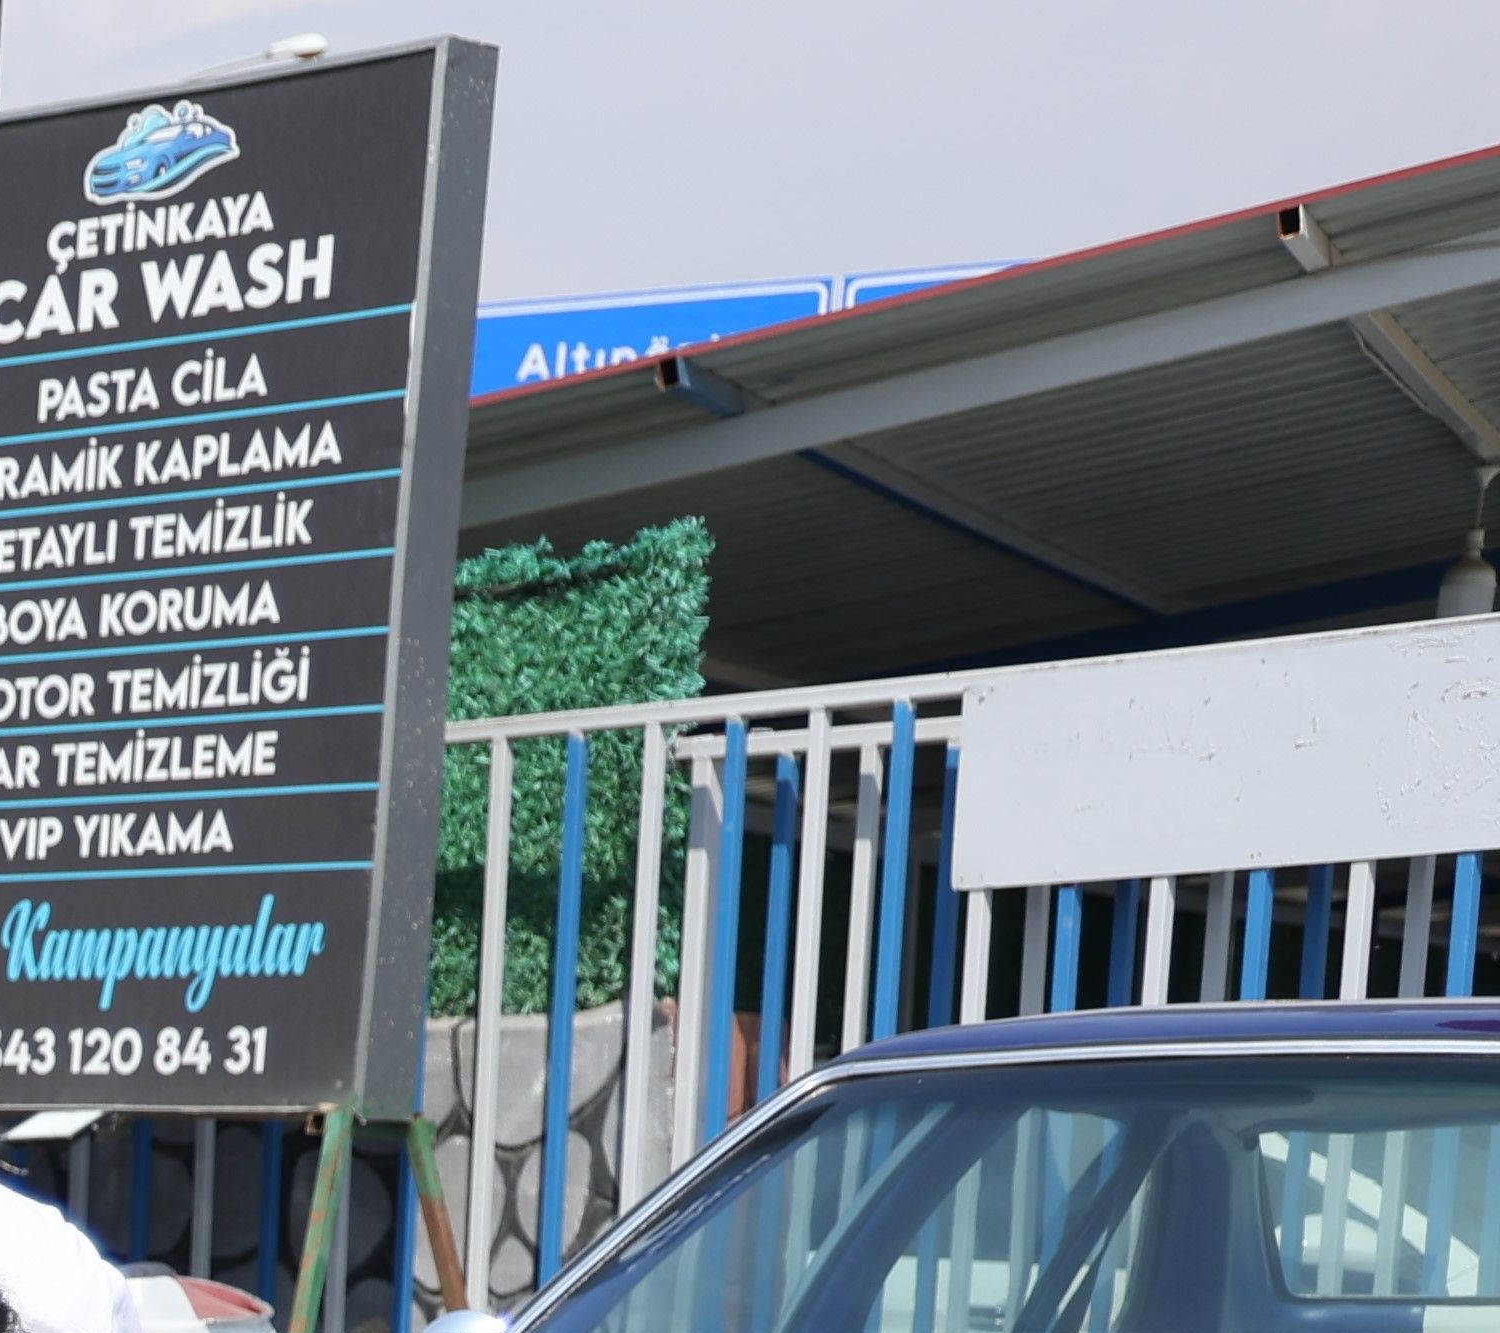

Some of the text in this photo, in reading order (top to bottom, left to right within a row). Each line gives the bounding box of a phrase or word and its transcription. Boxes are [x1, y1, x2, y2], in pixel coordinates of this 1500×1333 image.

[47, 189, 275, 273] ÇETİNKAYA
[140, 235, 336, 323] WASH
[38, 349, 268, 424] PASTA CİLA
[134, 420, 343, 487] KAPLAMA
[129, 489, 315, 553] TEMİZLİK
[99, 580, 281, 637] KORUMA
[107, 647, 312, 715] TEMİZLİĞİ
[52, 728, 279, 785] TEMİZLEME
[74, 810, 234, 857] YIKAMA
[0, 893, 326, 1012] Kampanyalar
[69, 1029, 144, 1076] 120
[154, 1027, 211, 1075] 84
[224, 1025, 267, 1074] 31
